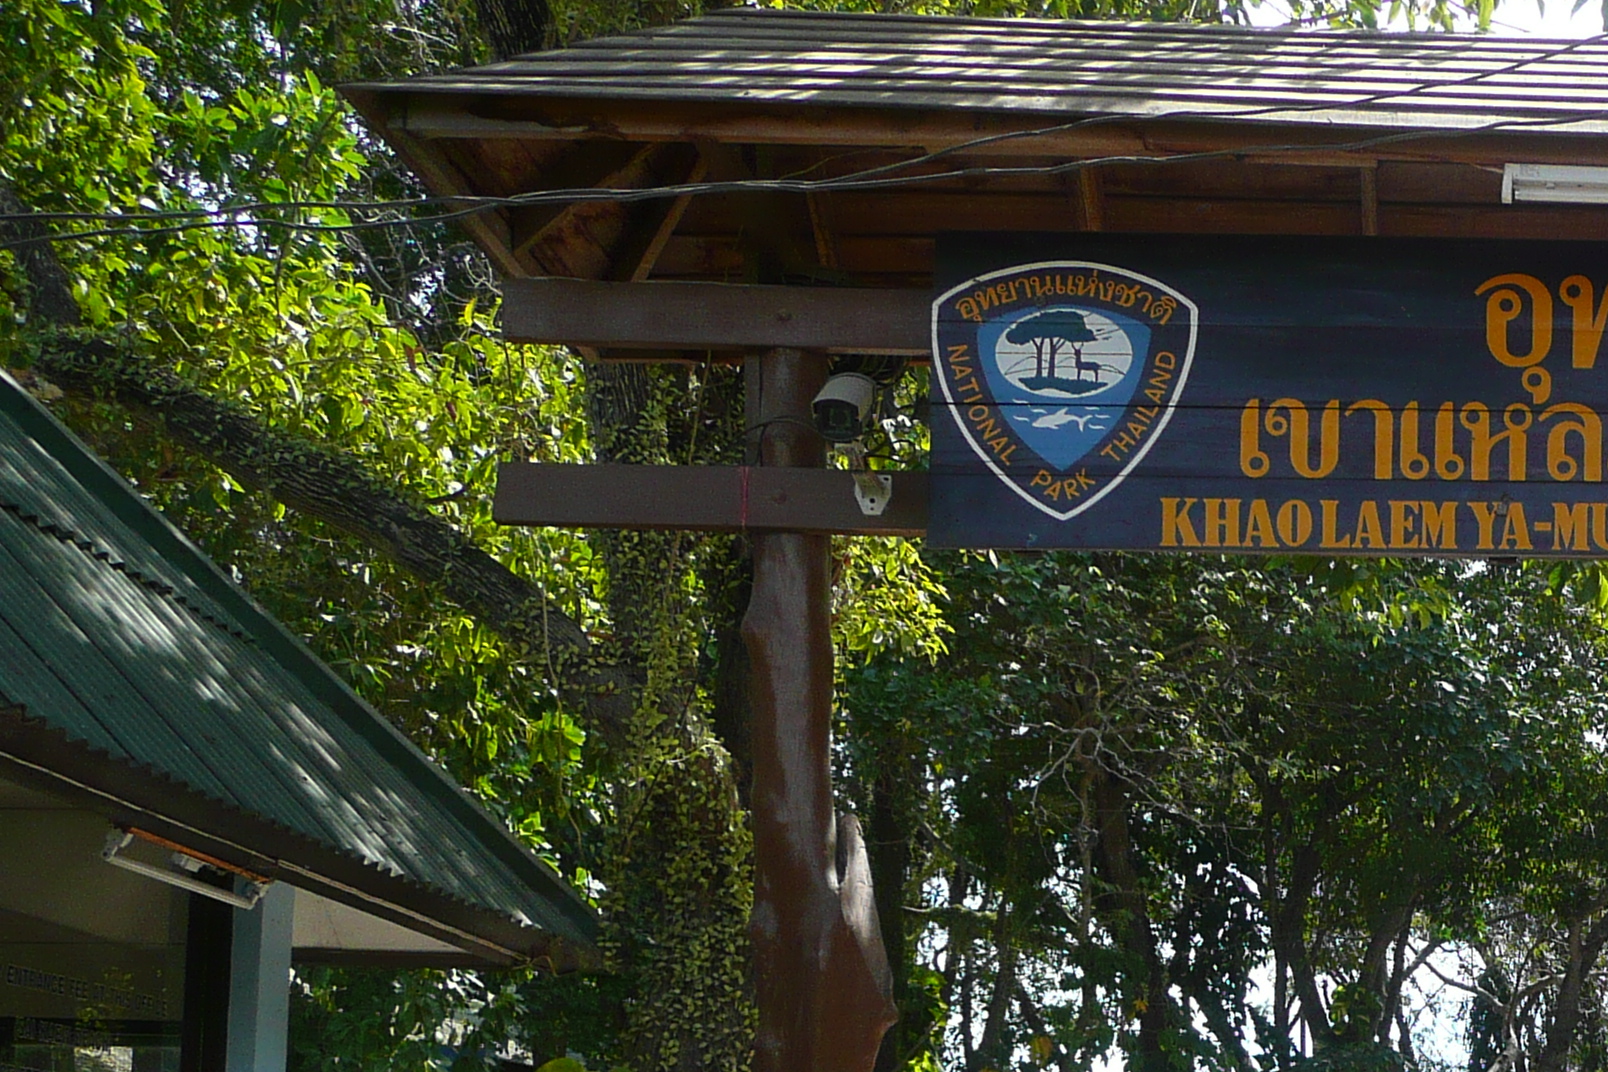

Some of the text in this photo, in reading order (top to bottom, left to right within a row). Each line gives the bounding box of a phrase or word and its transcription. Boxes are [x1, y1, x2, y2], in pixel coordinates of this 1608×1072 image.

[956, 269, 1178, 326] อุทยานแห่งชาติ
[946, 344, 1177, 502] NATIONAL PARK THAILAND
[1160, 497, 1314, 549] KHAO
[1319, 498, 1459, 550] LAEM
